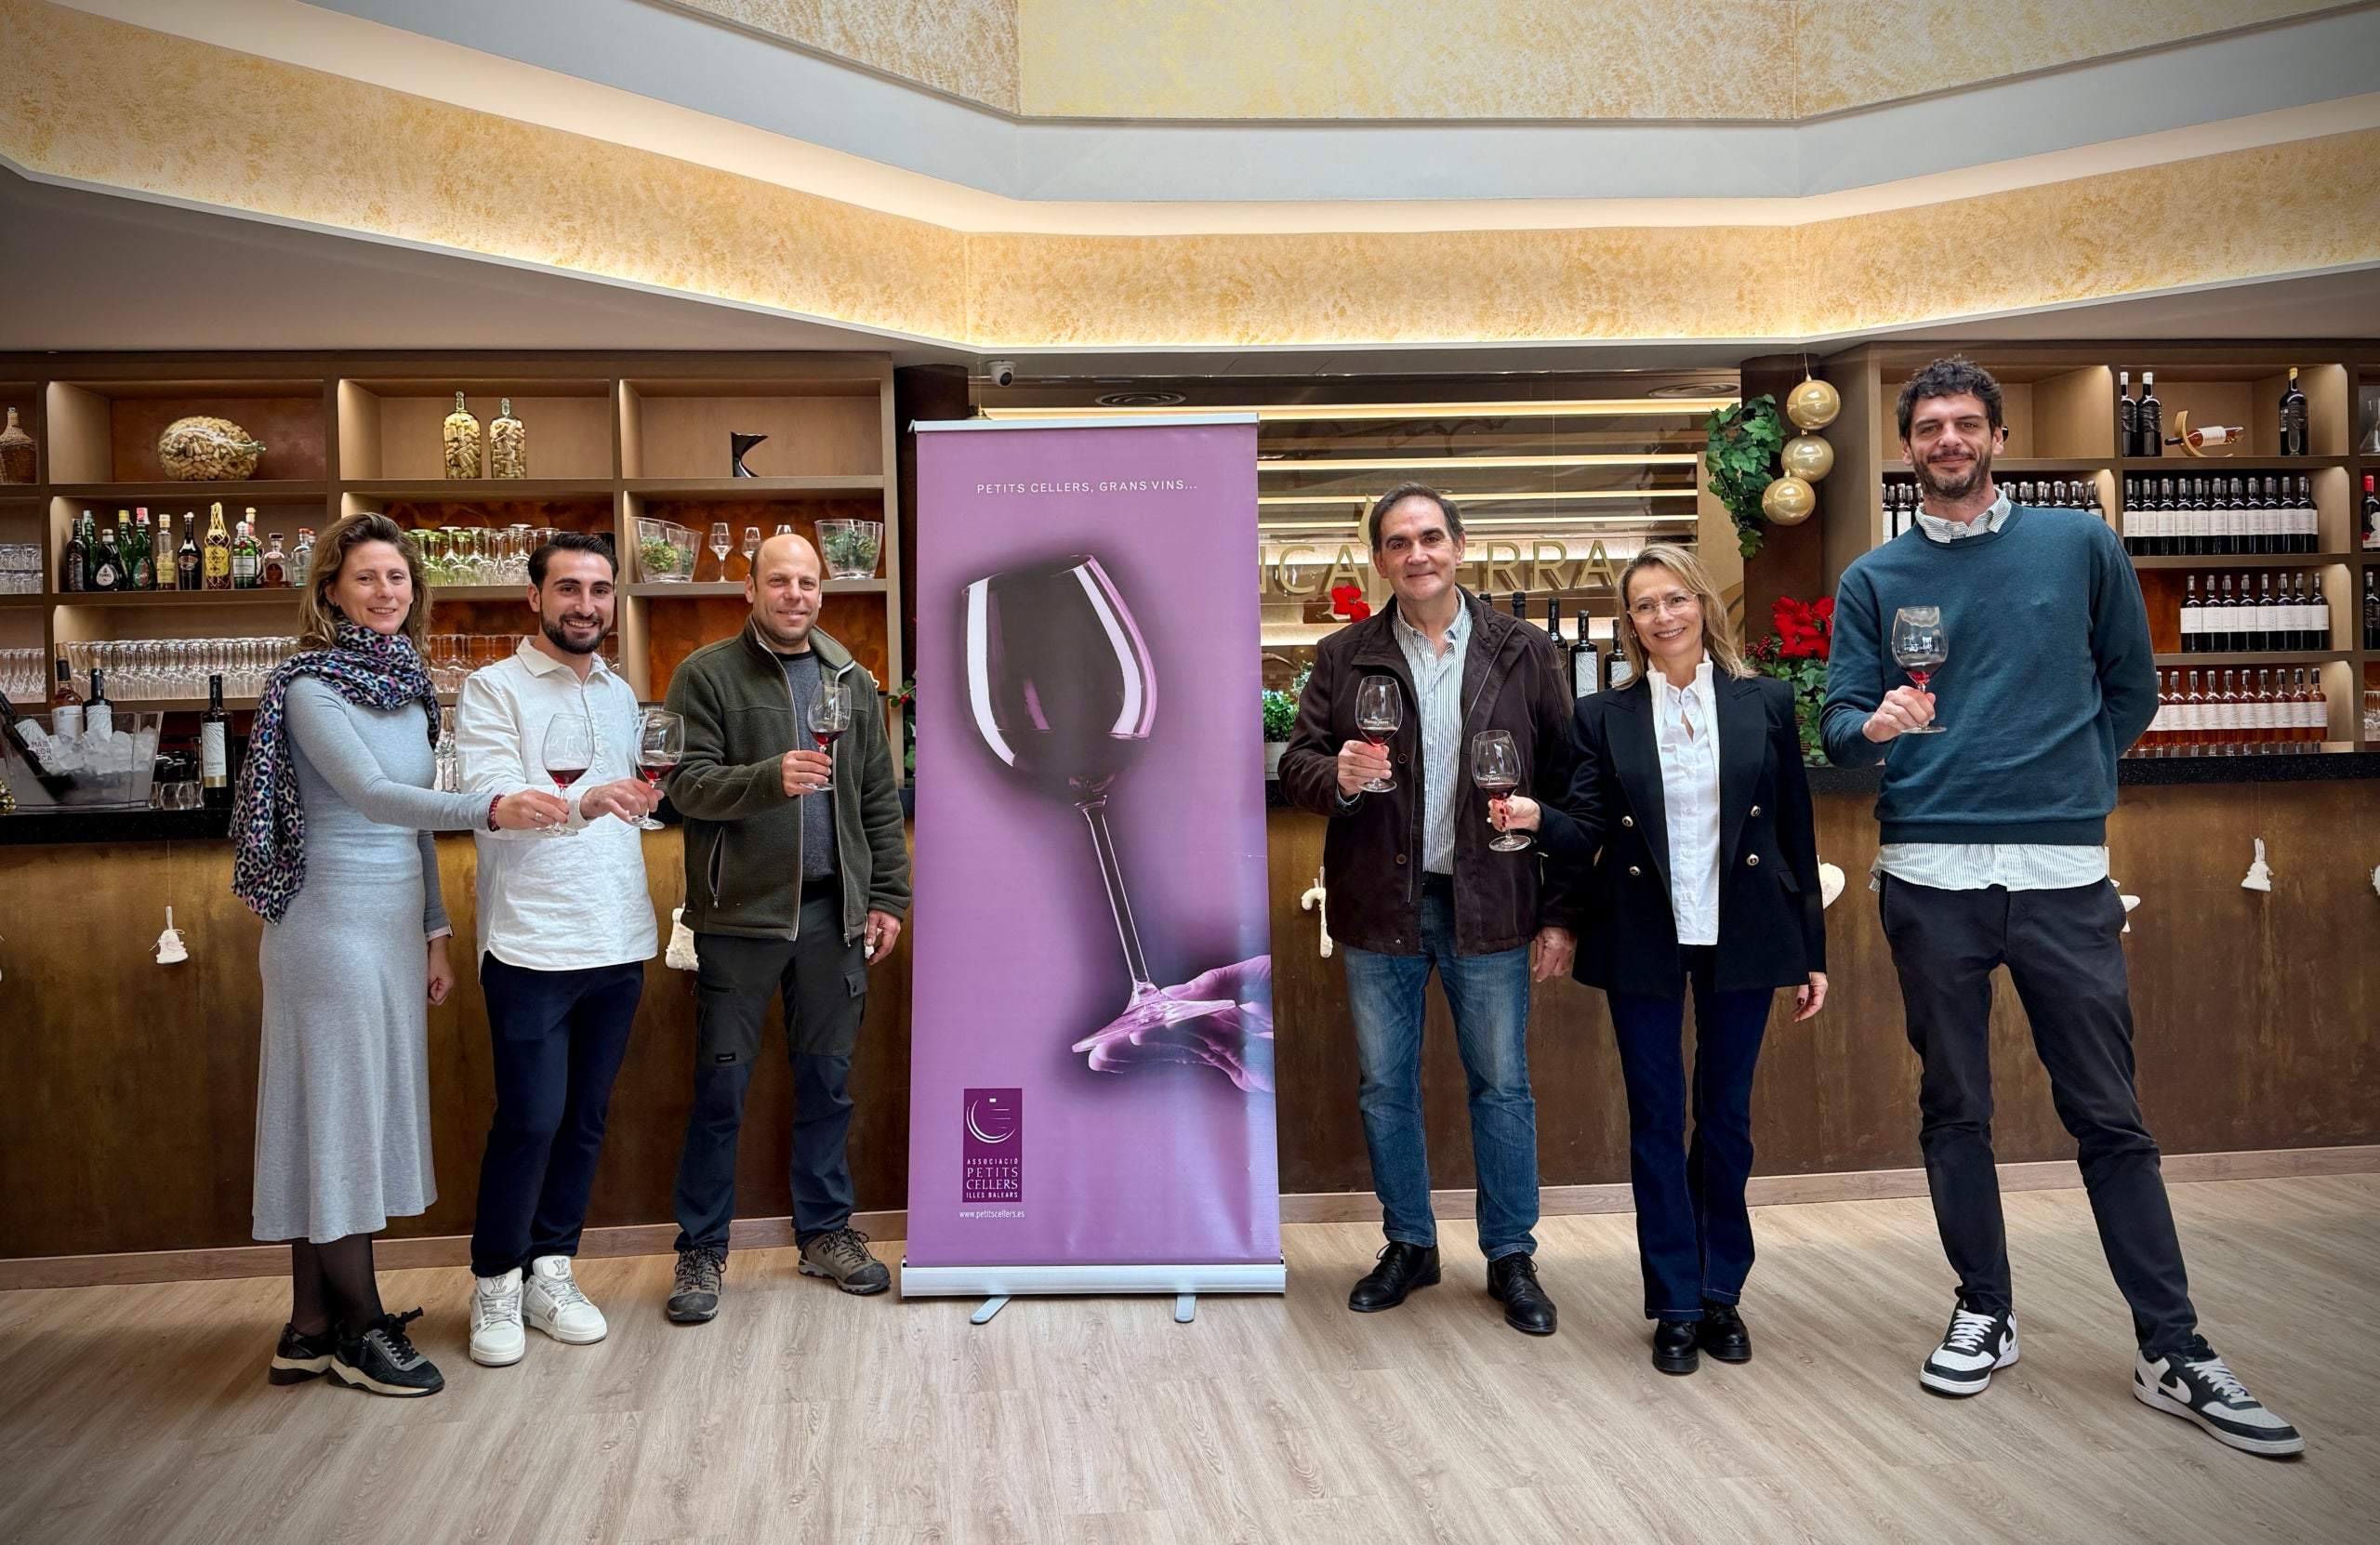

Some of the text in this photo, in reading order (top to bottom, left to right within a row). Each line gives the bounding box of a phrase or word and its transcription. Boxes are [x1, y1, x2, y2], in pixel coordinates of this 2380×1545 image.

[976, 480, 1197, 494] PETITS CELLERS, GRANS VINS...
[966, 1167, 1019, 1178] PETITS
[966, 1179, 1018, 1190] CELLERS
[959, 1209, 1025, 1220] www.petitscellers.es
